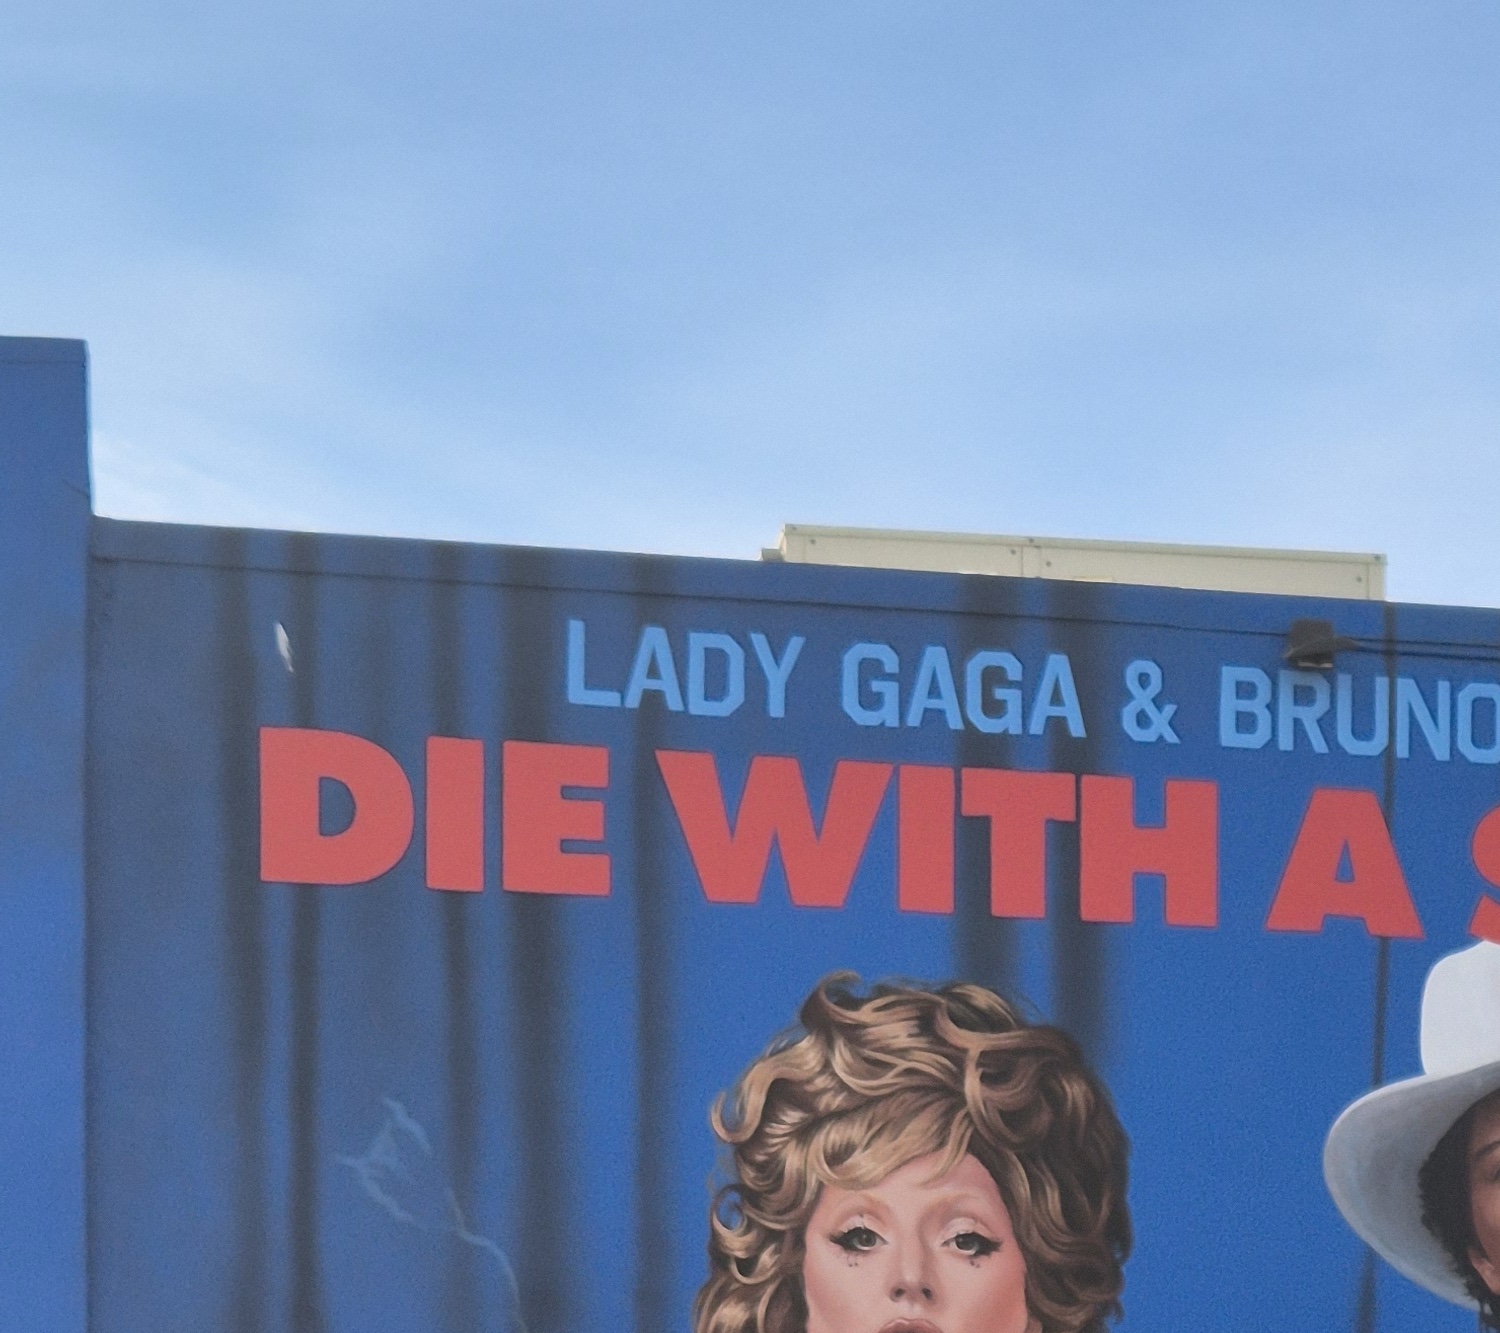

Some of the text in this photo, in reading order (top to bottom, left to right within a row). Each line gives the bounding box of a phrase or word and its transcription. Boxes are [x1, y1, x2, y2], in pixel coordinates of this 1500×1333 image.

[564, 618, 806, 719] LADY
[840, 642, 1087, 739] GAGA
[1120, 658, 1182, 745] &
[258, 727, 611, 897] DIE
[654, 749, 1219, 928] WITH
[1266, 788, 1424, 940] A
